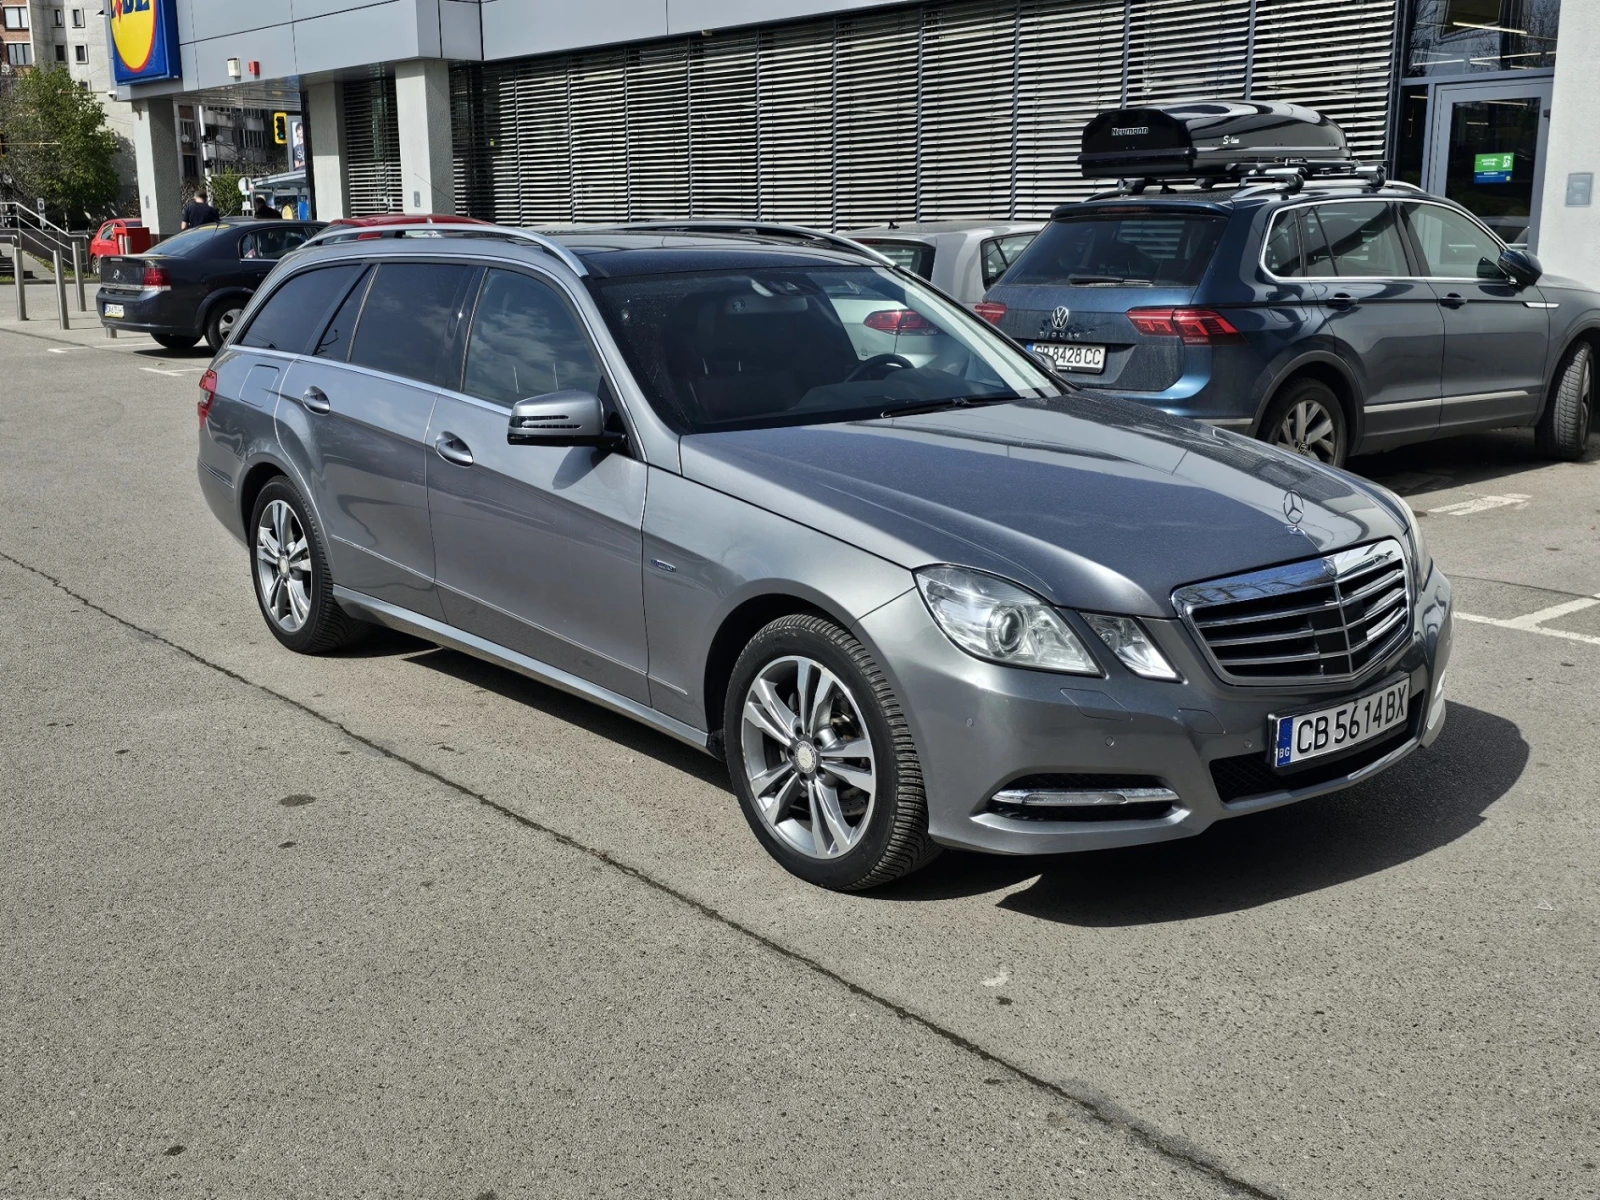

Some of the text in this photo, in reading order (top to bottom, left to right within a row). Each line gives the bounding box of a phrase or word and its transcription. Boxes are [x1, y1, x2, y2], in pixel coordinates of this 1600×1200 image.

[1052, 346, 1082, 364] 8428
[1084, 348, 1102, 365] CC
[1296, 684, 1407, 754] CB 5614 BX
[1278, 746, 1290, 758] BG
